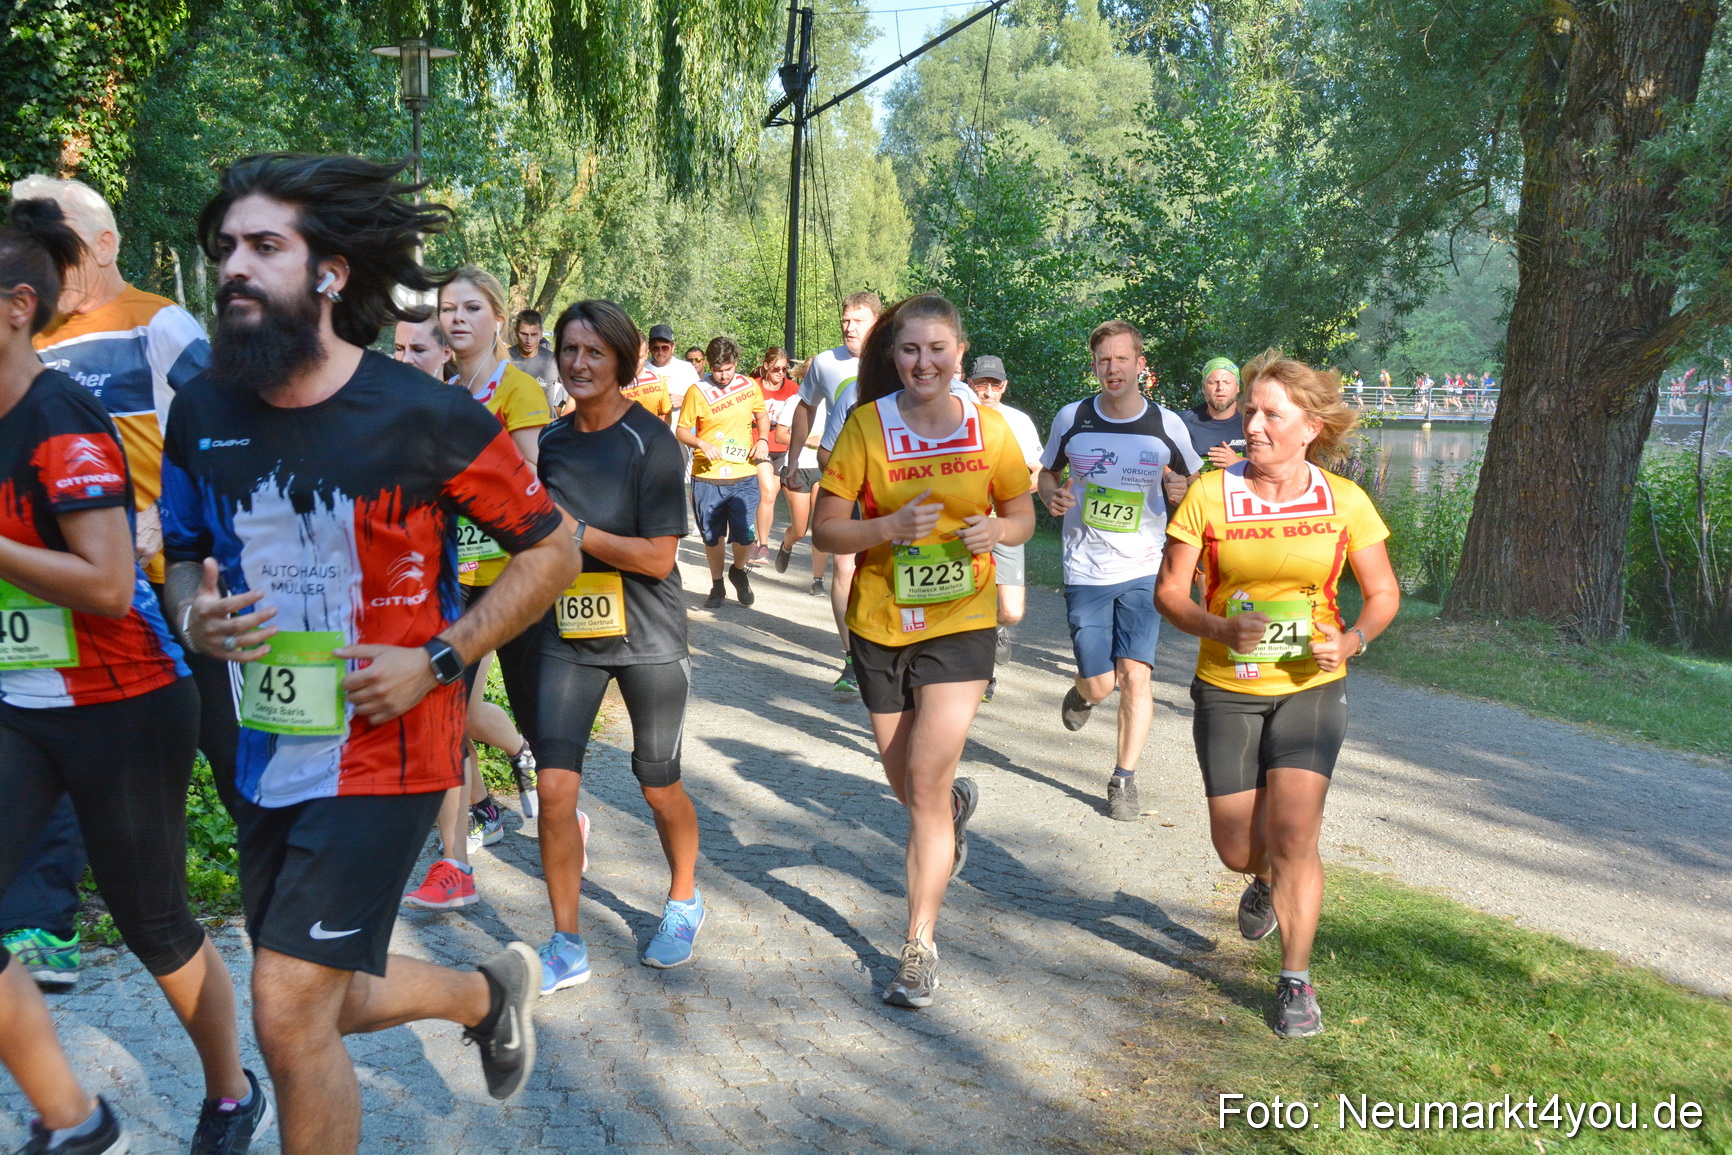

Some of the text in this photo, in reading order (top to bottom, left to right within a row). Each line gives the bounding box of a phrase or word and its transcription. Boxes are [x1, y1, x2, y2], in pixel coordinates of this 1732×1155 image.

[711, 390, 756, 415] MAX BÖGL
[725, 446, 747, 457] 1273
[888, 457, 990, 483] MAX BÖGL
[1091, 500, 1134, 521] 1473
[1225, 521, 1338, 541] MAX BÖGL
[261, 564, 337, 579] AUTOHAUS
[904, 560, 965, 587] 1223
[271, 579, 325, 596] MÜLLER
[559, 595, 611, 619] 1680
[1260, 621, 1298, 644] 21
[259, 665, 297, 705] 43
